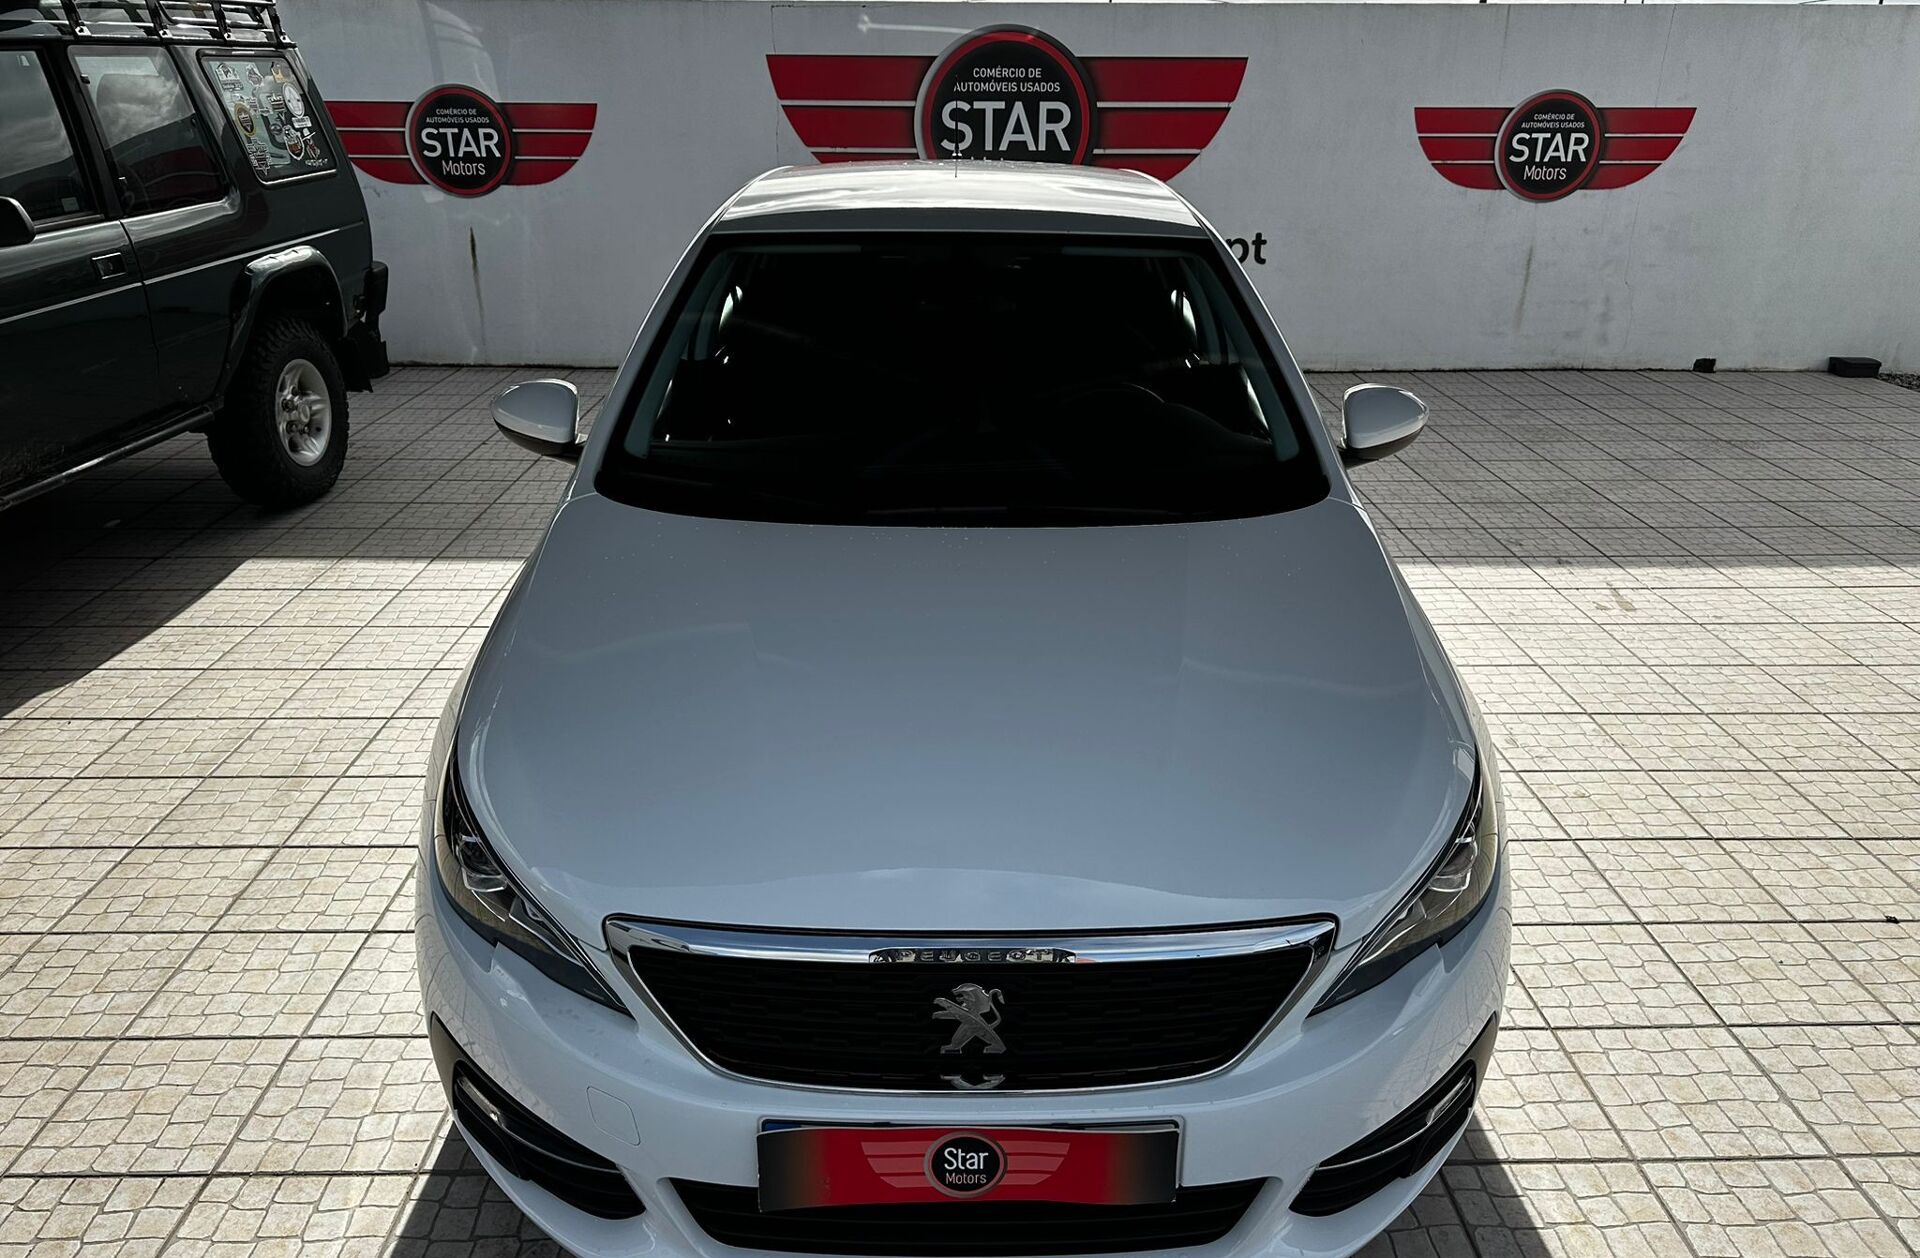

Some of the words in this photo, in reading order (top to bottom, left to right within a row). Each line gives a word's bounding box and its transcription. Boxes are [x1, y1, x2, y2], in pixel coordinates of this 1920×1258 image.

[973, 65, 1026, 78] COMÉRCIO
[1028, 68, 1042, 78] DE
[954, 80, 1018, 92] AUTOMÓVEIS
[1020, 82, 1061, 92] USADOS
[436, 107, 468, 115] COMÉRCIO
[940, 101, 1072, 151] STAR
[421, 127, 501, 158] STAR
[1509, 132, 1590, 162] STAR
[442, 160, 486, 175] Motors
[1523, 165, 1567, 180] Motors
[896, 950, 1053, 963] PEUGEOT
[944, 1147, 989, 1170] Star
[945, 1172, 987, 1185] Motors
